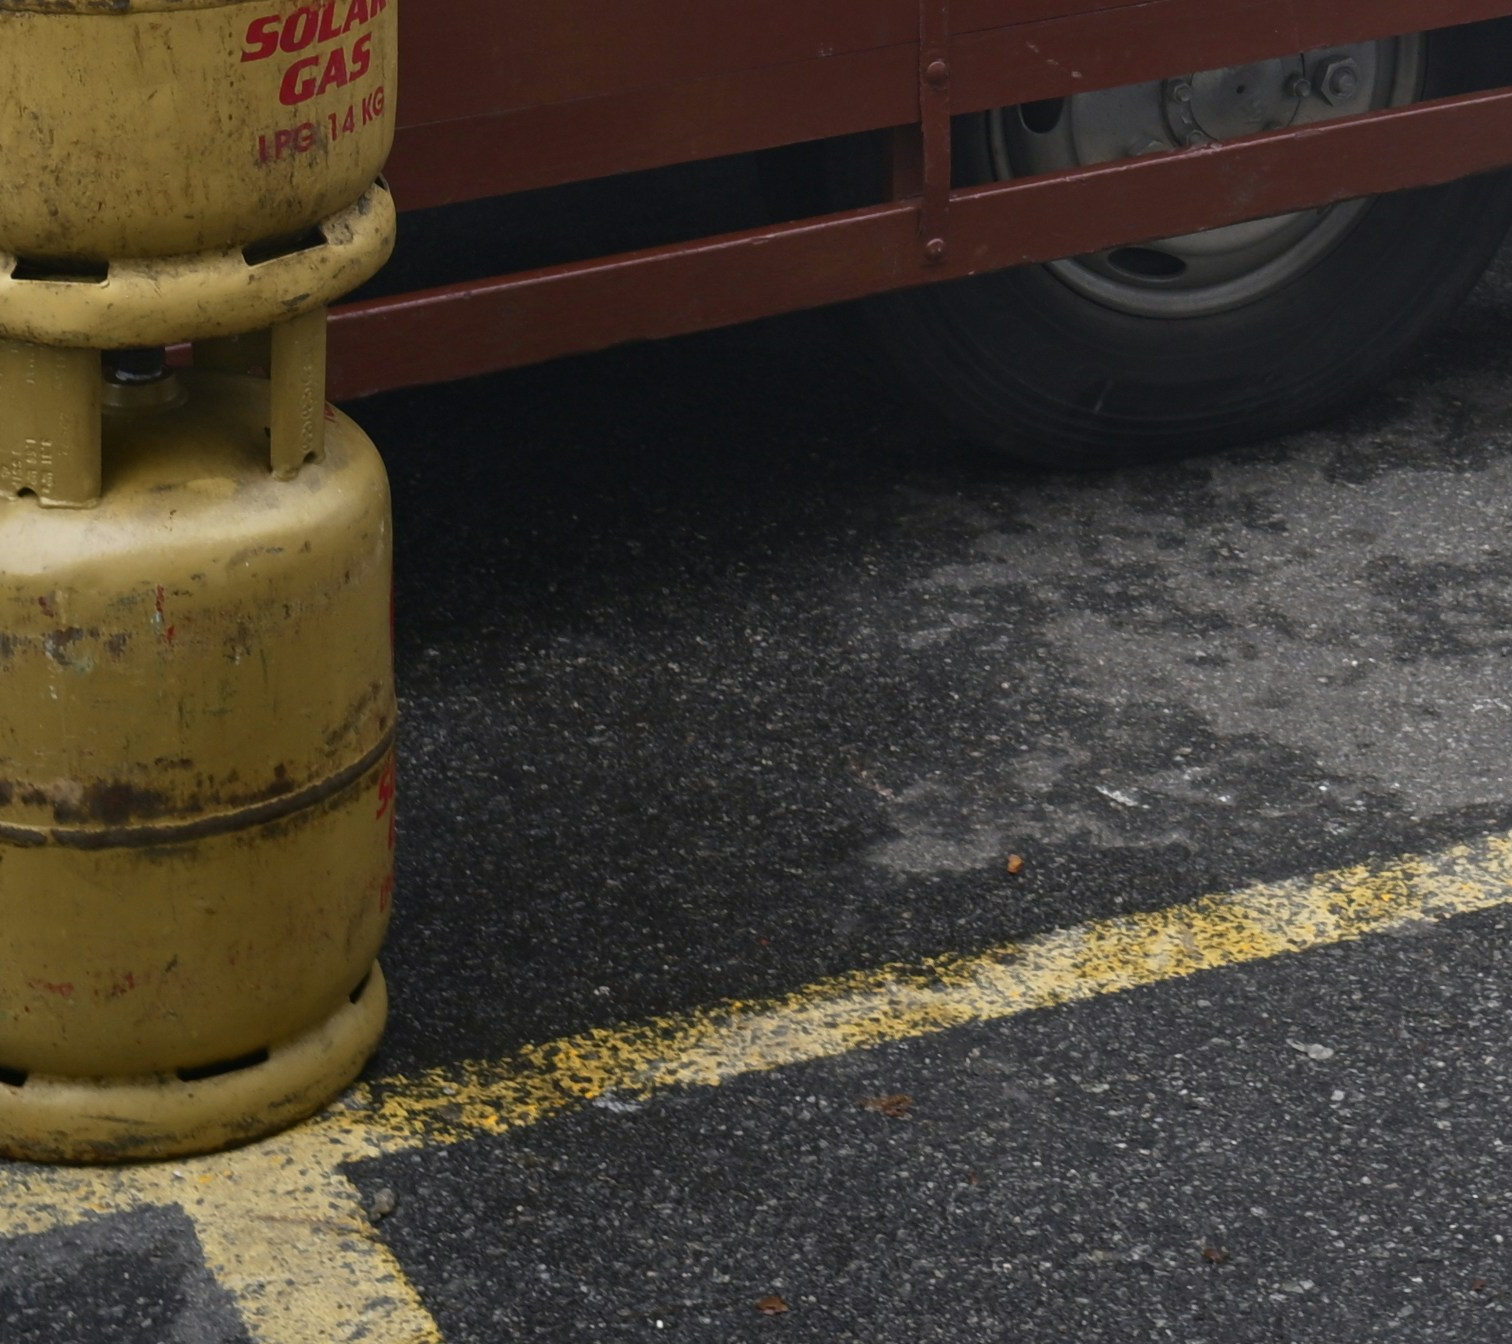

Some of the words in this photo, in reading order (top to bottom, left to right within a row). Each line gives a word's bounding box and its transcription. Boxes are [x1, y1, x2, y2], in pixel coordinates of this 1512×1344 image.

[279, 31, 372, 107] GAS
[327, 104, 355, 142] 14
[361, 85, 385, 126] KG
